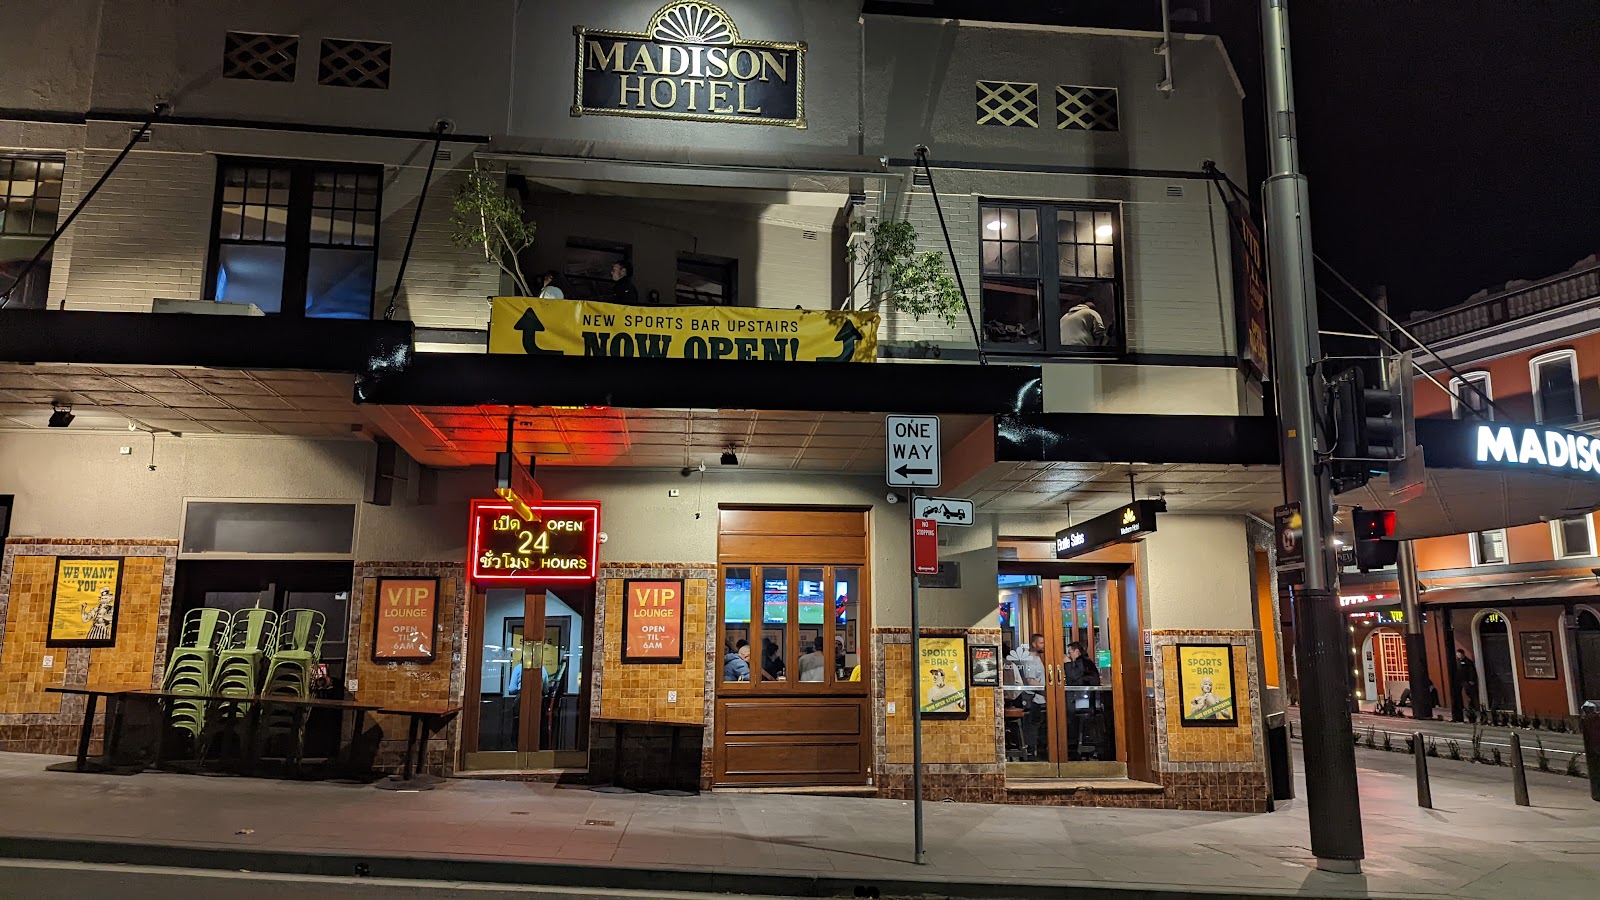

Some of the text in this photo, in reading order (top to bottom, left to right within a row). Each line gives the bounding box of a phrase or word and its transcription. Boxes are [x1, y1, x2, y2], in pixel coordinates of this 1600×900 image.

[585, 40, 790, 83] MADISON
[618, 74, 762, 114] HOTEL
[582, 314, 799, 333] NEW SPORTS BAR UPSTAIRS
[581, 331, 800, 362] NOW OPEN!
[895, 422, 931, 439] ONE
[893, 443, 933, 460] WAY
[493, 514, 521, 531] เปิด
[546, 519, 583, 532] OPEN
[518, 530, 549, 554] 24
[1056, 531, 1085, 552] Bottle Sales
[479, 549, 530, 570] ชั่วโมง
[541, 557, 587, 570] HOURS
[63, 566, 115, 579] WE WANT
[77, 580, 98, 592] YOU
[387, 587, 429, 606] VIP
[635, 588, 676, 607] VIP
[384, 608, 428, 618] LOUNGE
[633, 609, 674, 618] LOUNGE
[392, 625, 418, 633] OPEN
[641, 625, 666, 633] OPEN
[647, 633, 659, 641] TIL
[393, 642, 415, 650] 6AM
[642, 641, 663, 649] 6AM
[921, 648, 958, 657] SPORTS
[975, 650, 994, 659] UFC
[1187, 658, 1222, 666] SPORTS
[1196, 667, 1214, 675] BAR
